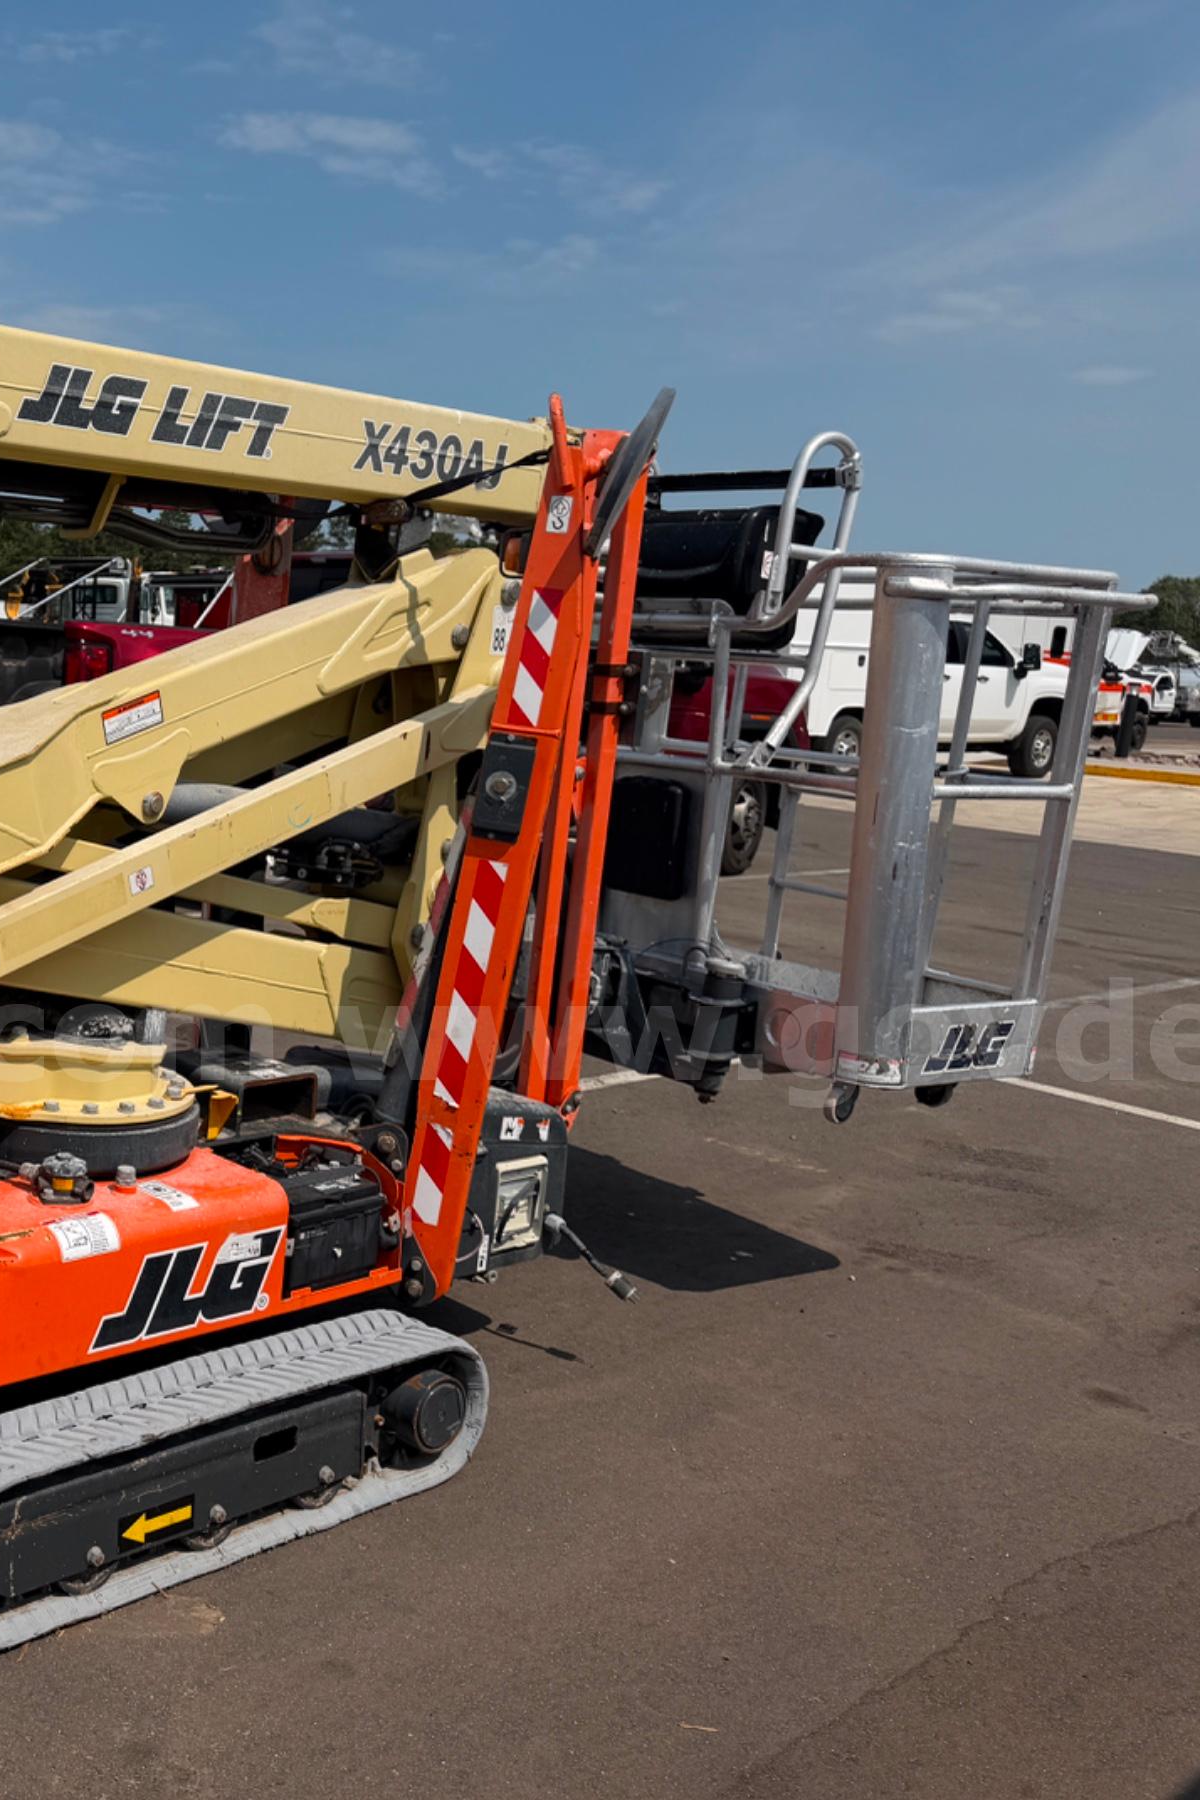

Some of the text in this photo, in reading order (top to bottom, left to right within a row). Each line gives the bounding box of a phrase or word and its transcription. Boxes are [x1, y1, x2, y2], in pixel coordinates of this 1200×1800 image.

[15, 361, 291, 458] JLG LIFT
[353, 419, 509, 491] X430AJ
[921, 1020, 1016, 1076] JLG
[87, 1224, 288, 1354] JLG
